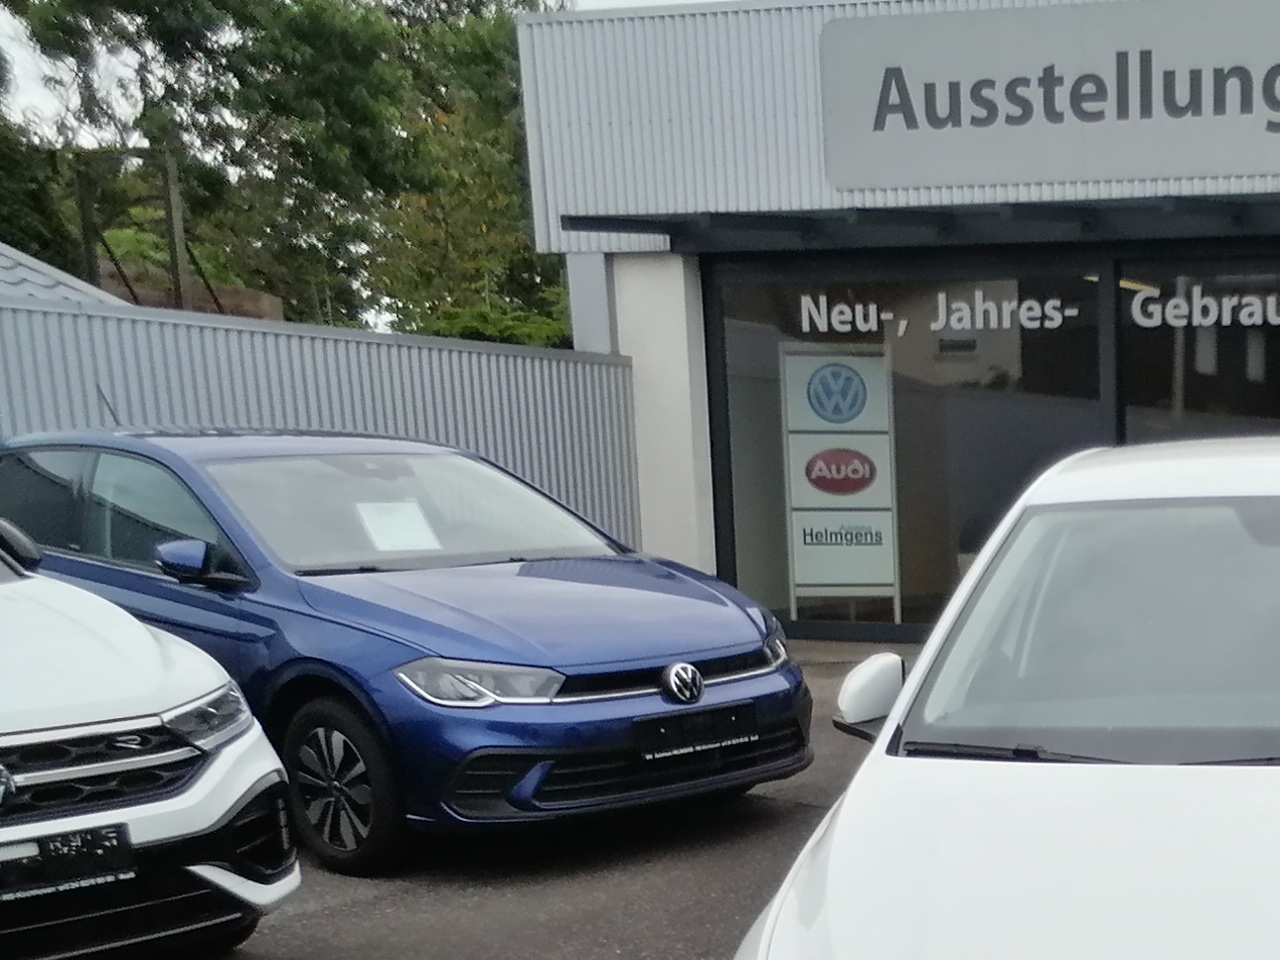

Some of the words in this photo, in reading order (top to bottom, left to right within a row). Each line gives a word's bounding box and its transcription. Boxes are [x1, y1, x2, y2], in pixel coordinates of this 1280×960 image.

[799, 293, 908, 337] Neu-,
[929, 290, 1080, 333] Jahres-
[809, 458, 871, 481] Audi
[803, 527, 883, 546] Helmgens
